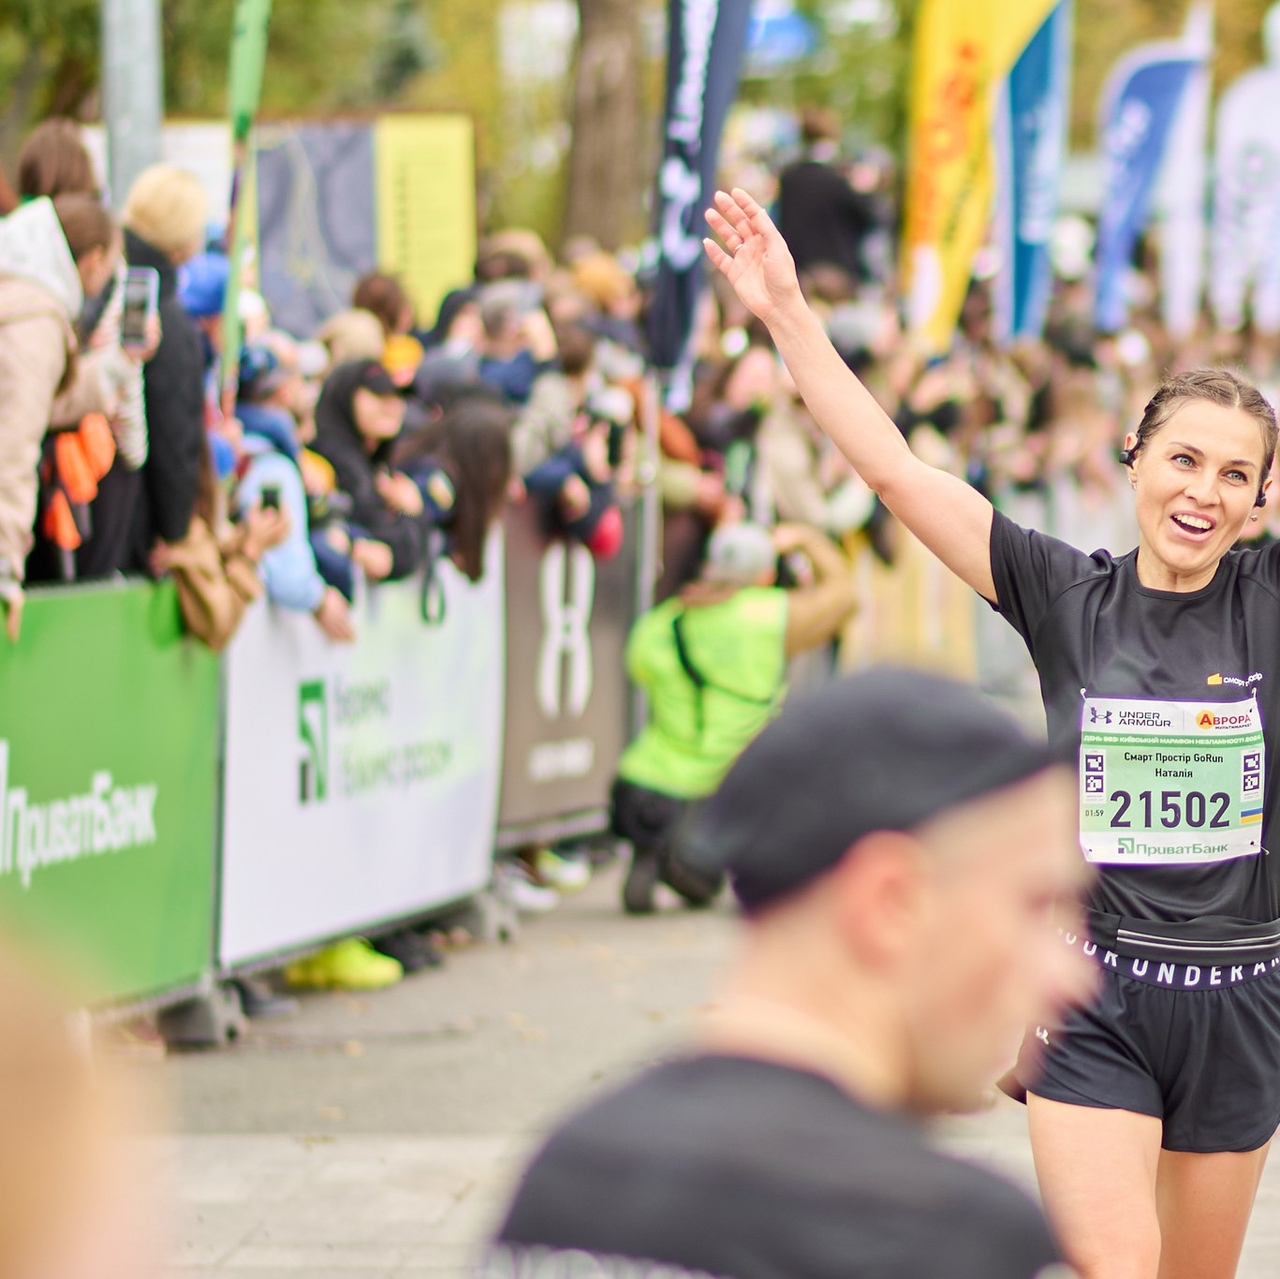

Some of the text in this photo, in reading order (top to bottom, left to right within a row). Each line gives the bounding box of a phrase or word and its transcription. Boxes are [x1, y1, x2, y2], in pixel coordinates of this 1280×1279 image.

[1119, 711, 1160, 720] UNDER
[1118, 718, 1172, 727] ARMOUR
[1124, 752, 1224, 764] Смарт Простір GoRun
[1155, 768, 1193, 778] Наталія
[1085, 809, 1104, 817] 01:59
[1110, 790, 1231, 828] 21502
[1136, 842, 1228, 857] ПриватБанк
